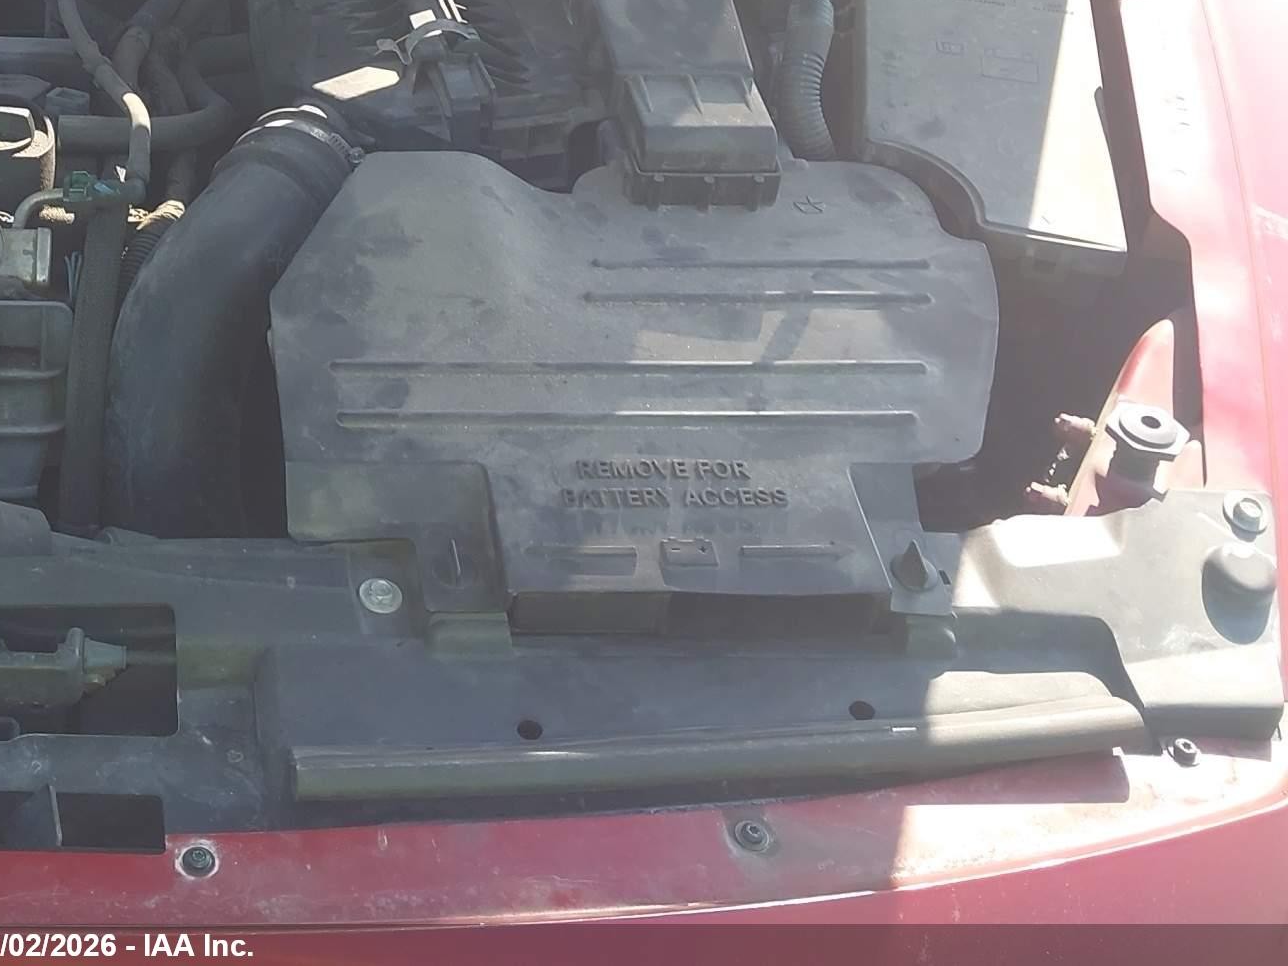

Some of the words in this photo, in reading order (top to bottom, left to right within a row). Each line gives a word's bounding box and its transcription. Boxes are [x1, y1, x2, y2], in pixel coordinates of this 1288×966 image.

[576, 458, 690, 481] REMOVE
[695, 458, 752, 481] FOR
[560, 487, 672, 508] BATTERY
[684, 487, 790, 508] ACCESS
